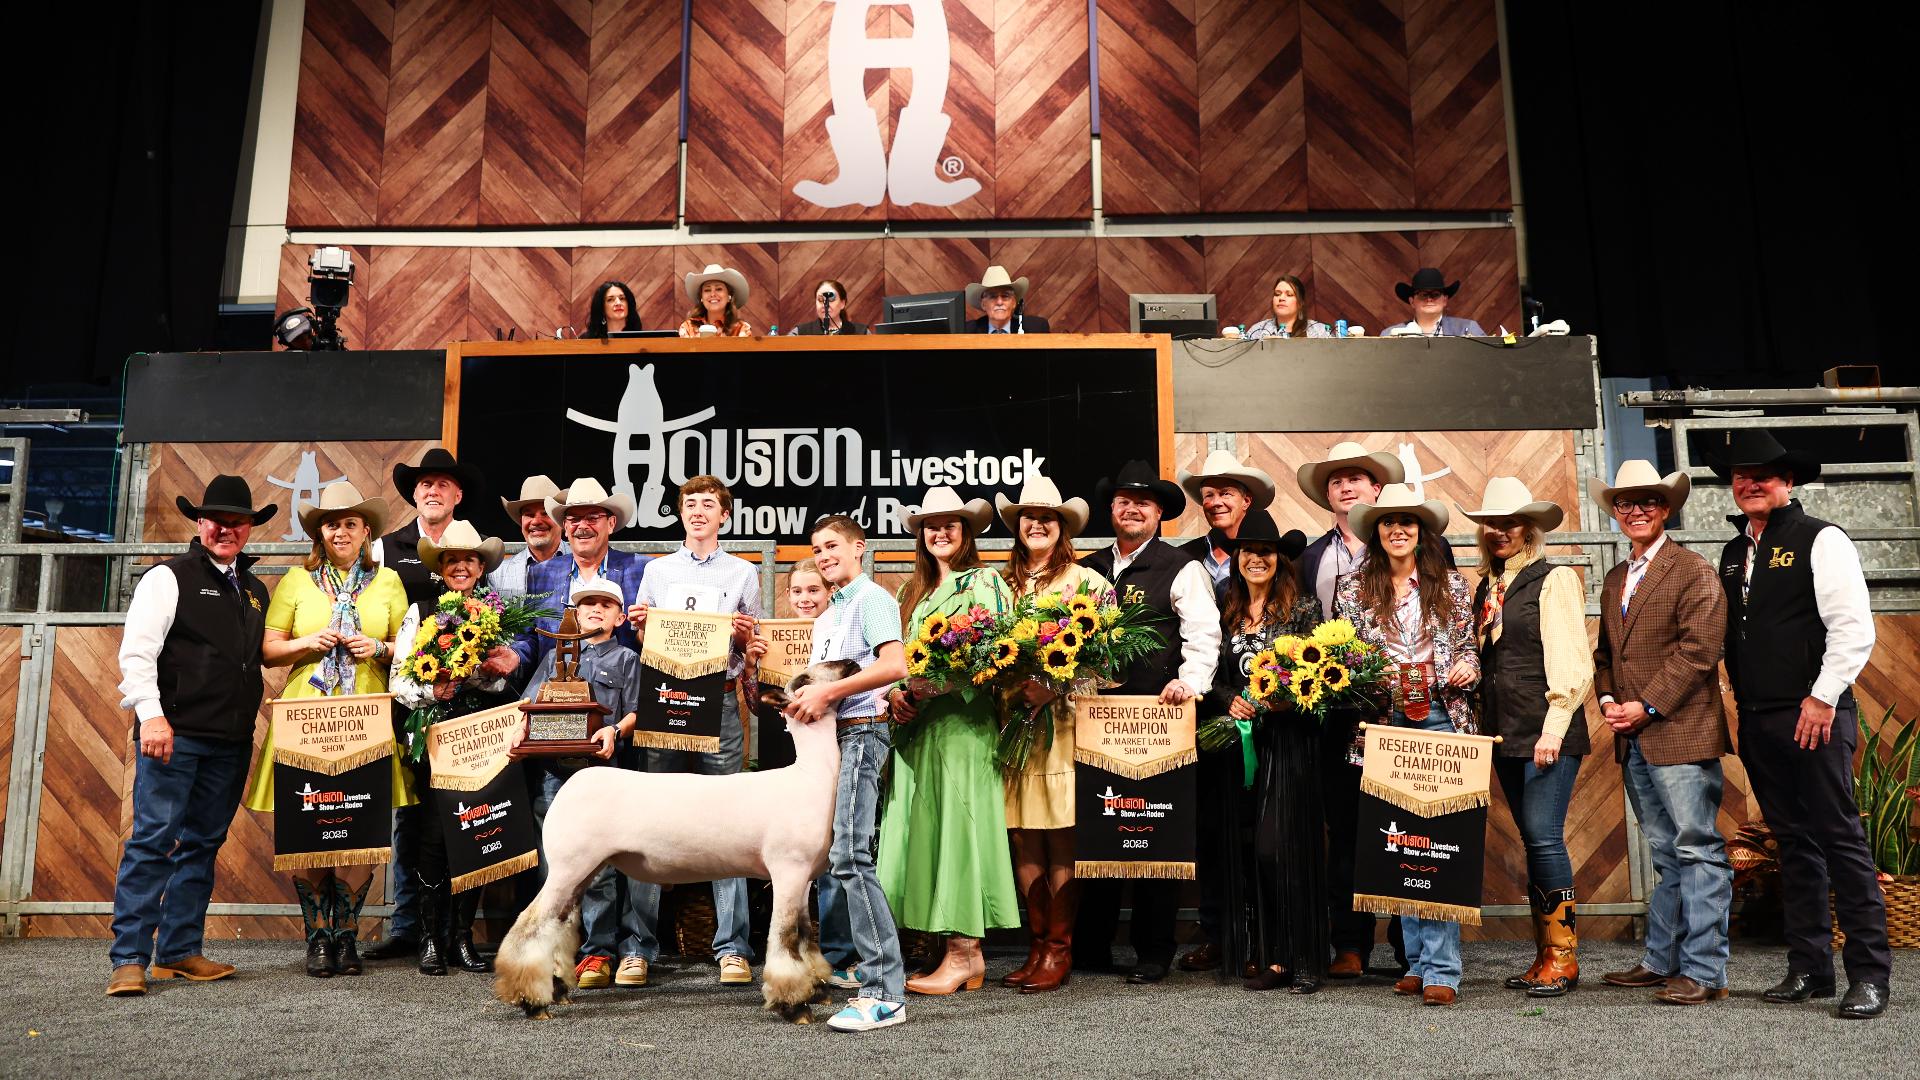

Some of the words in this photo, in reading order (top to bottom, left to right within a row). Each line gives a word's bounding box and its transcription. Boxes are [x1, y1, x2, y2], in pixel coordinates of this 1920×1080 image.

[870, 448, 1046, 486] Livestock
[660, 620, 692, 630] RESERVE
[694, 622, 716, 632] BREED
[668, 628, 708, 640] CHAMPION
[772, 629, 814, 642] RESERV
[821, 638, 830, 660] 3
[286, 706, 336, 721] RESERVE
[340, 704, 378, 718] GRAND
[1089, 706, 1140, 720] RESERVE
[1142, 708, 1183, 720] GRAND
[302, 719, 364, 734] CHAMPION
[436, 724, 480, 746] RESERVE
[481, 714, 516, 734] GRAND
[1104, 722, 1168, 734] CHAMPION
[312, 734, 344, 744] MARKET
[346, 734, 368, 742] LAMB
[452, 732, 504, 756] CHAMPION
[1102, 738, 1112, 746] JR.
[1114, 738, 1146, 746] MARKET
[1148, 738, 1170, 746] LAMB
[322, 744, 346, 752] SHOW
[1380, 738, 1432, 756] RESERVE
[1436, 744, 1478, 760] GRAND
[1394, 754, 1461, 774] CHAMPION
[1390, 770, 1401, 780] JR.
[1404, 772, 1436, 782] MARKET
[1440, 776, 1464, 786] LAMB
[1414, 783, 1438, 792] SHOW
[1122, 840, 1148, 848] 2025
[1404, 878, 1431, 889] 2025
